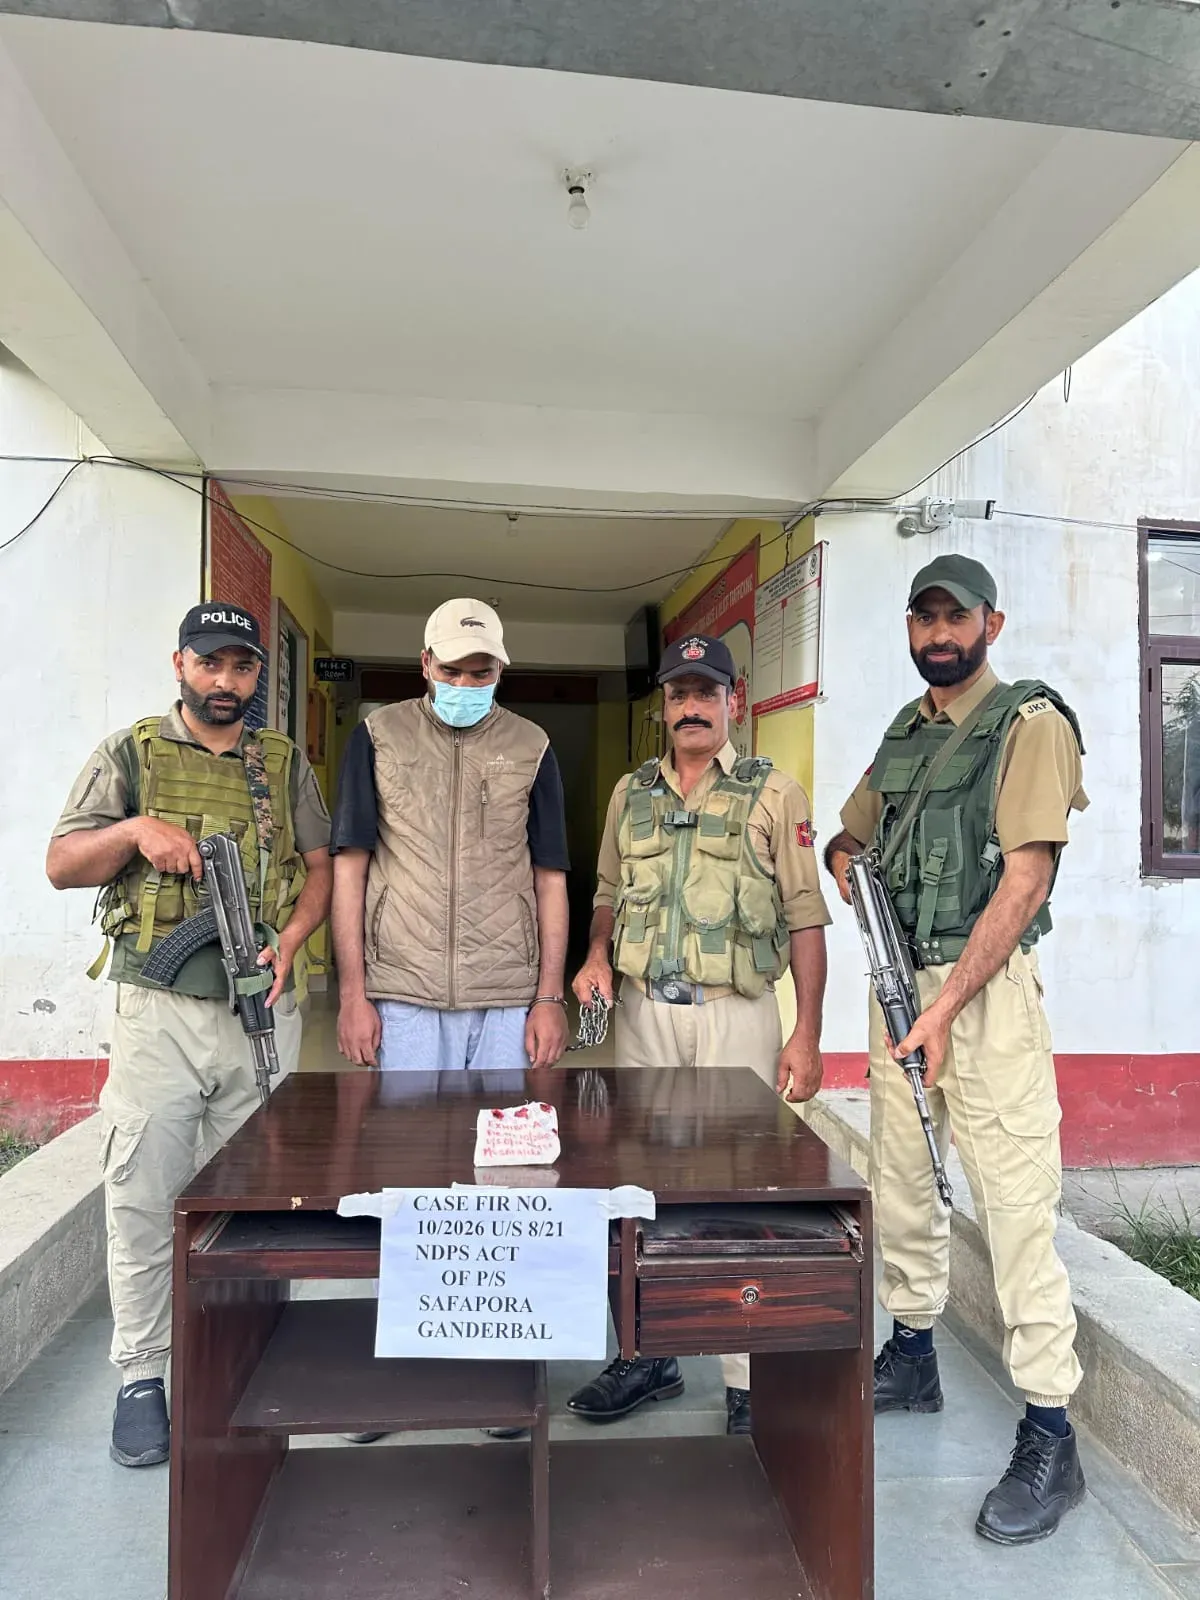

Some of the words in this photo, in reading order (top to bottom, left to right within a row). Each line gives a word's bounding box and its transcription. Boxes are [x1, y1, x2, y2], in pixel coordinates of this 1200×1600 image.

[201, 610, 252, 631] POLICE
[1027, 702, 1048, 713] JKP
[413, 1195, 469, 1212] CASE
[476, 1195, 511, 1212] FIR
[517, 1195, 553, 1212] NO.
[417, 1219, 485, 1237] 10/2026
[492, 1220, 523, 1237] U/S
[528, 1220, 564, 1237] 8/21
[415, 1244, 470, 1261] NDPS
[476, 1245, 520, 1262] ACT
[441, 1270, 471, 1287] OF
[477, 1270, 507, 1287] P/S
[418, 1294, 533, 1313] SAFAPORA
[417, 1320, 553, 1340] GANDERBAL
